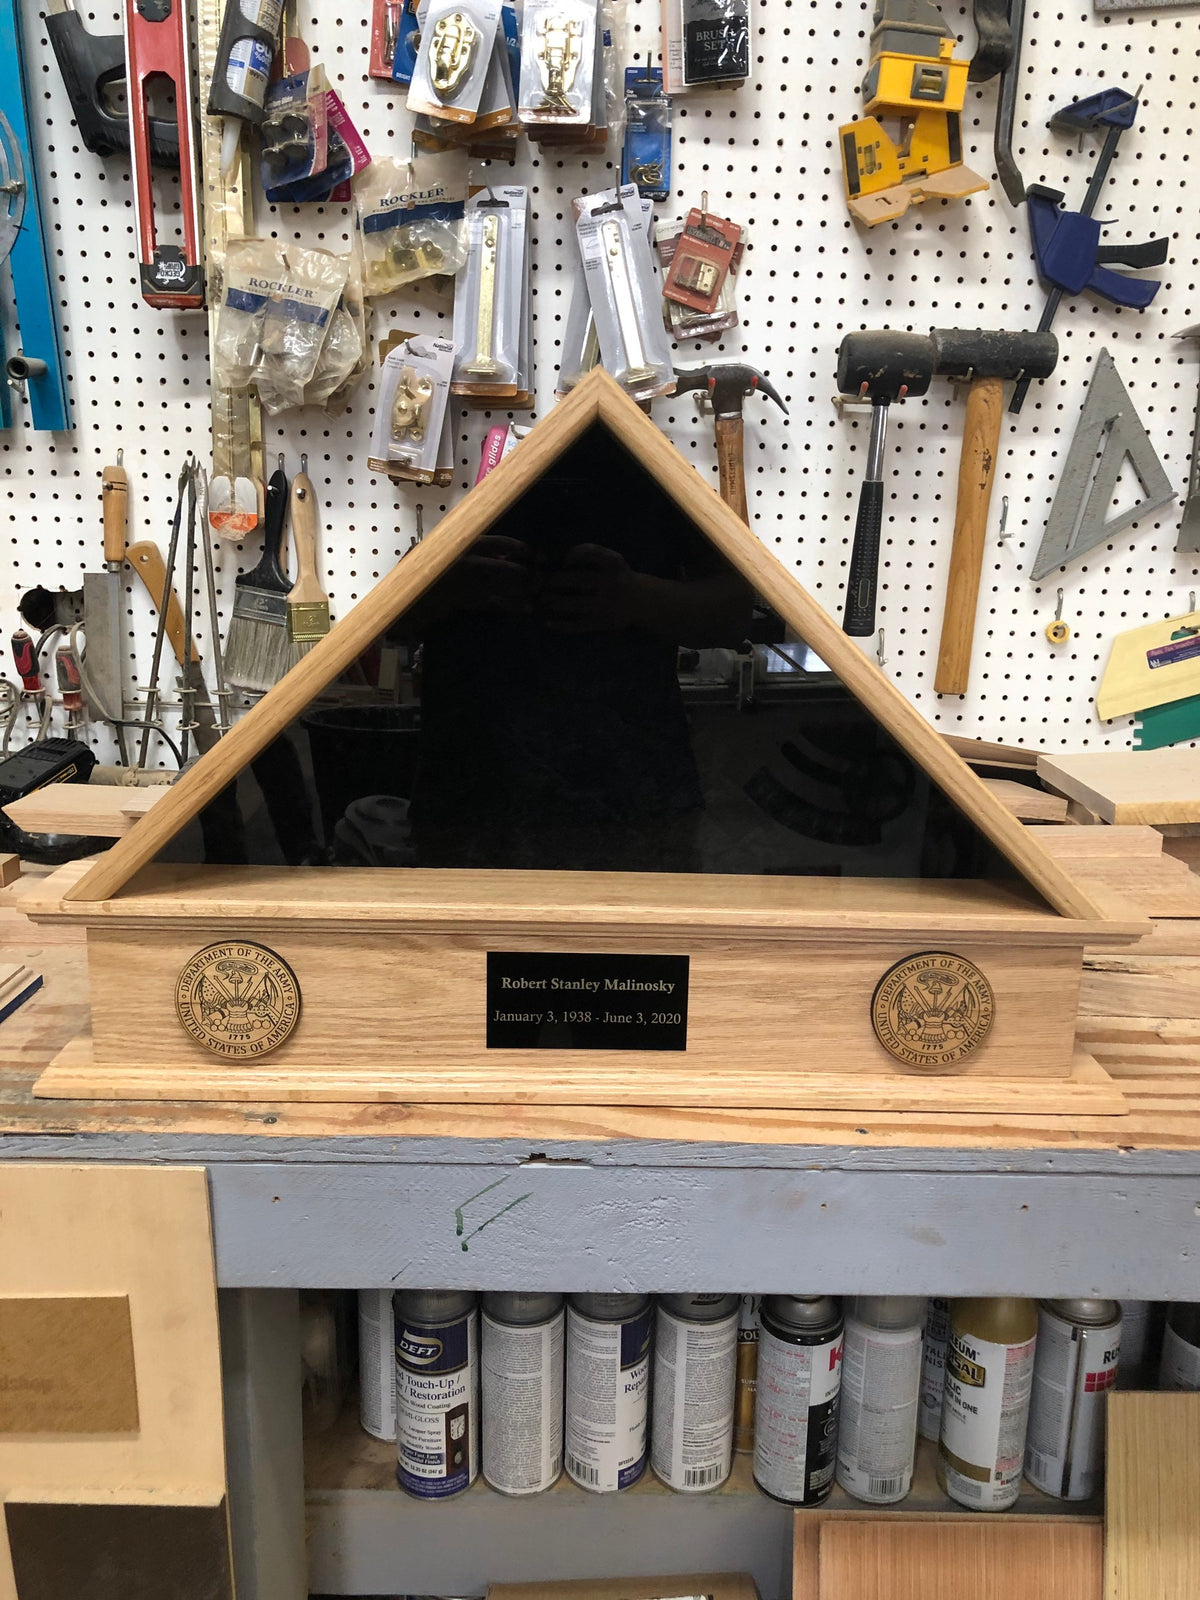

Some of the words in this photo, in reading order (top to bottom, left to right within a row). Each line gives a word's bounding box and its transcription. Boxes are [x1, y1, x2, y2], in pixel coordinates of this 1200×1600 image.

[696, 29, 734, 42] BRUS
[704, 41, 726, 51] SET
[380, 188, 445, 207] ROCKLER
[248, 277, 314, 298] ROCKLER
[488, 434, 502, 466] glides
[181, 948, 233, 993] DEPARTMENT
[237, 947, 252, 957] OF
[255, 951, 275, 969] THE
[273, 968, 293, 994] ARMY
[501, 977, 547, 989] Robert
[551, 978, 600, 992] Stanley
[604, 979, 675, 994] Malinosky
[881, 959, 937, 1003] DEPARTMENT
[940, 959, 955, 969] OF
[957, 963, 976, 979] THE
[973, 978, 990, 1005] ARMY
[493, 1010, 543, 1024] January
[546, 1011, 558, 1024] 3,
[563, 1011, 592, 1023] 1938
[603, 1012, 632, 1024] June
[636, 1012, 647, 1025] 3,
[650, 1012, 681, 1025] 2020
[180, 1001, 206, 1041] UNITED
[206, 1038, 247, 1054] STATES
[250, 1042, 265, 1053] OF
[267, 1002, 295, 1046] AMERICA
[877, 1012, 900, 1050] UNITED
[899, 1048, 938, 1064] STATES
[942, 1053, 956, 1064] OF
[959, 1013, 990, 1056] AMERICA
[400, 1340, 437, 1356] DEFT
[406, 1374, 455, 1389] Touch-Up
[410, 1385, 466, 1400] Restoration
[962, 1402, 979, 1415] ONE
